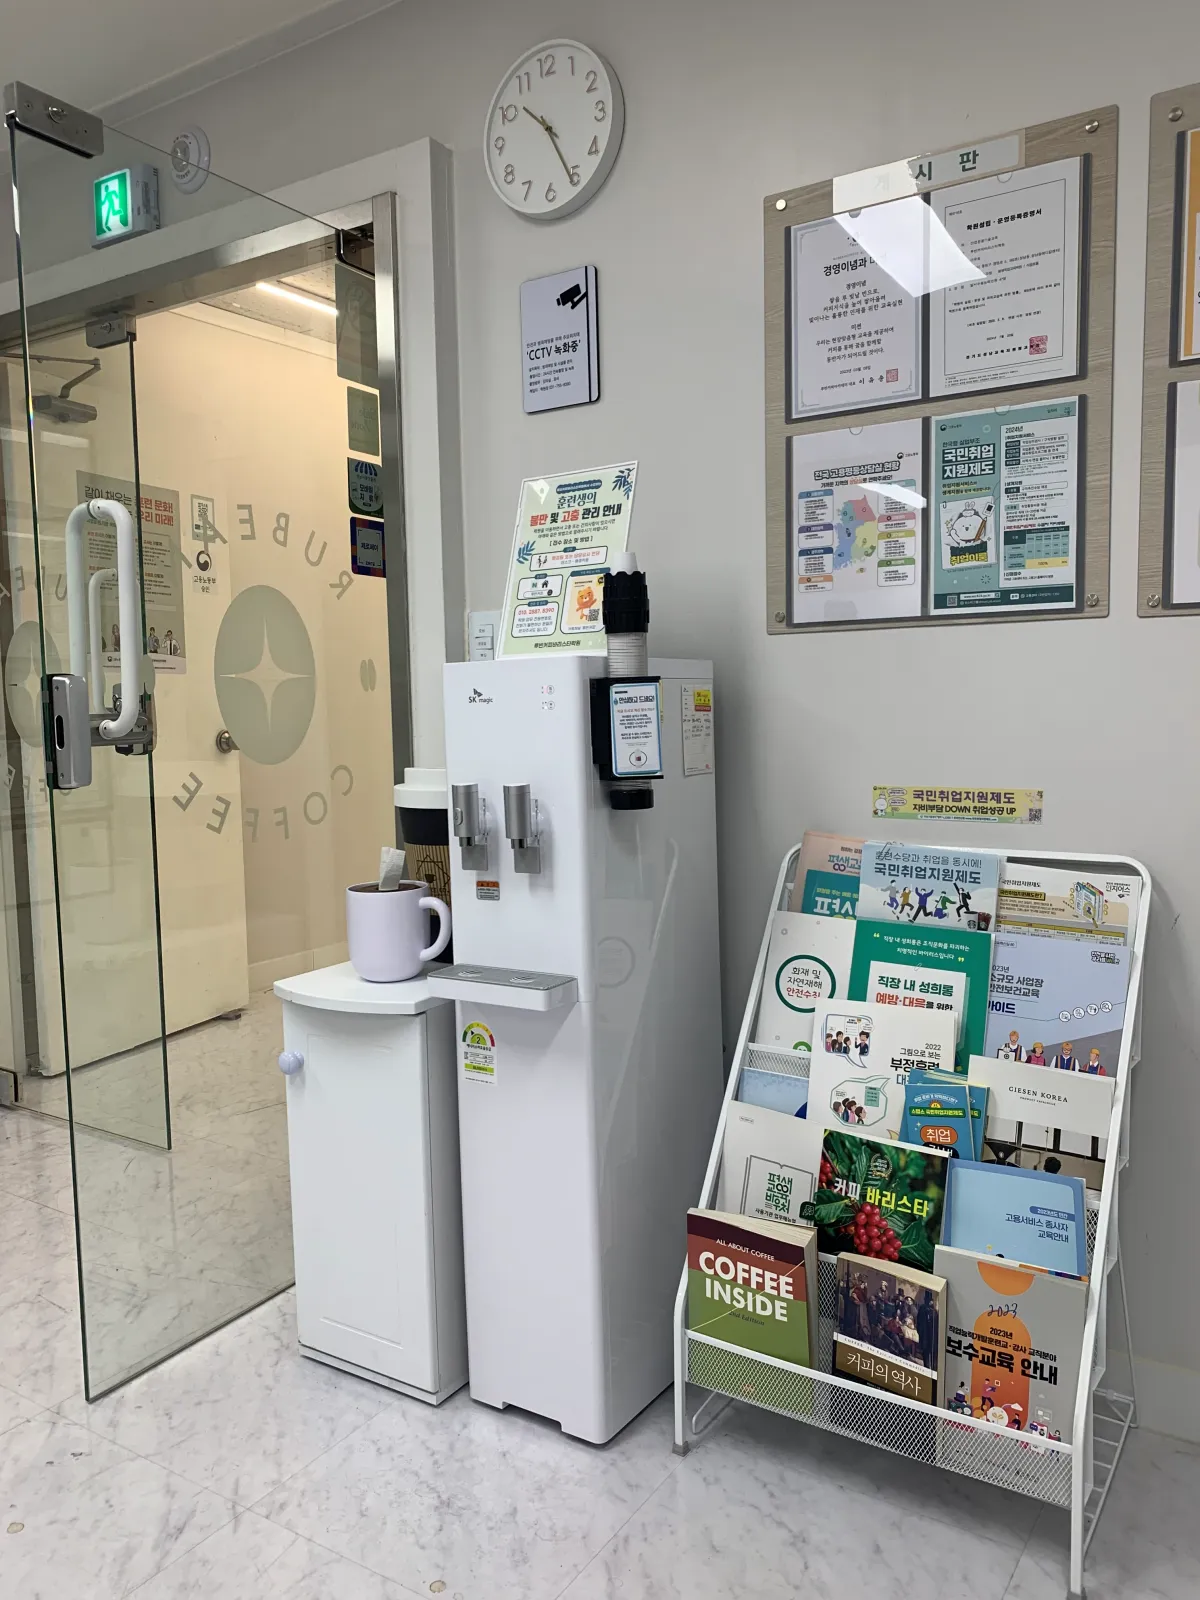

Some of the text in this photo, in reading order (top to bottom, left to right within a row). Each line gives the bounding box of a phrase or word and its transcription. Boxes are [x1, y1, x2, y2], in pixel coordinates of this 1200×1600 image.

[537, 54, 556, 79] 12
[568, 56, 575, 76] 1
[516, 72, 531, 95] 11
[585, 71, 598, 93] 2
[499, 104, 518, 125] 10
[594, 100, 606, 122] 3
[494, 136, 505, 156] 9
[588, 135, 600, 156] 4
[504, 164, 515, 184] 8
[915, 149, 980, 182] 시 판
[569, 165, 580, 187] 5
[522, 180, 532, 201] 7
[545, 182, 557, 203] 6
[823, 257, 867, 277] 경영이념과
[846, 280, 867, 290] 경영이념
[1005, 426, 1023, 434] 2024년
[958, 437, 981, 446] 실업부조
[943, 444, 994, 461] 국민취업
[814, 469, 830, 480] 전국
[943, 462, 994, 479] 지원제도
[155, 500, 173, 513] 문화!
[557, 491, 597, 509] 훈련생의
[155, 513, 174, 527] 미래!
[530, 503, 622, 527] 불만 및 고충 관리 안내
[194, 575, 217, 584] 고용노동부
[468, 696, 477, 704] SK
[912, 789, 1016, 804] 국민취업지원제도
[912, 804, 1016, 816] 자비부담 DOWN 취업성공 UP
[923, 854, 949, 866] 취업을
[952, 856, 982, 868] 동시에!
[874, 862, 981, 885] 국민취업지원제도
[883, 935, 894, 943] 직장
[901, 938, 922, 946] 성희롱은
[923, 940, 948, 950] 조직문화를
[949, 943, 970, 952] 파괴하는
[897, 947, 955, 960] 치명적인 바이러스입니다
[792, 967, 821, 979] 화재 및
[787, 976, 822, 989] 자연재해
[878, 975, 954, 997] 직장 내 성희롱
[1016, 976, 1044, 988] 사업장
[476, 1036, 481, 1045] 2
[899, 1048, 941, 1060] 그림으로 보는
[1008, 1086, 1068, 1103] GIESEN KOREA
[926, 1129, 950, 1143] 취업
[834, 1177, 929, 1217] 커피 바리스타
[755, 1208, 773, 1217] 사용기관
[1005, 1213, 1068, 1232] 고용서비스 종사자
[1038, 1230, 1069, 1243] 교육안내
[716, 1238, 775, 1262] ALL ABOUT COFFEE
[699, 1251, 794, 1300] COFFEE
[705, 1278, 788, 1322] INSIDE
[742, 1313, 765, 1326] Edition
[986, 1303, 1018, 1319] 2023
[989, 1326, 1013, 1340] 2023년
[946, 1335, 1058, 1386] 보수교육 안내
[1028, 1347, 1057, 1363] 교직분야
[847, 1353, 922, 1396] 커피의 역사
